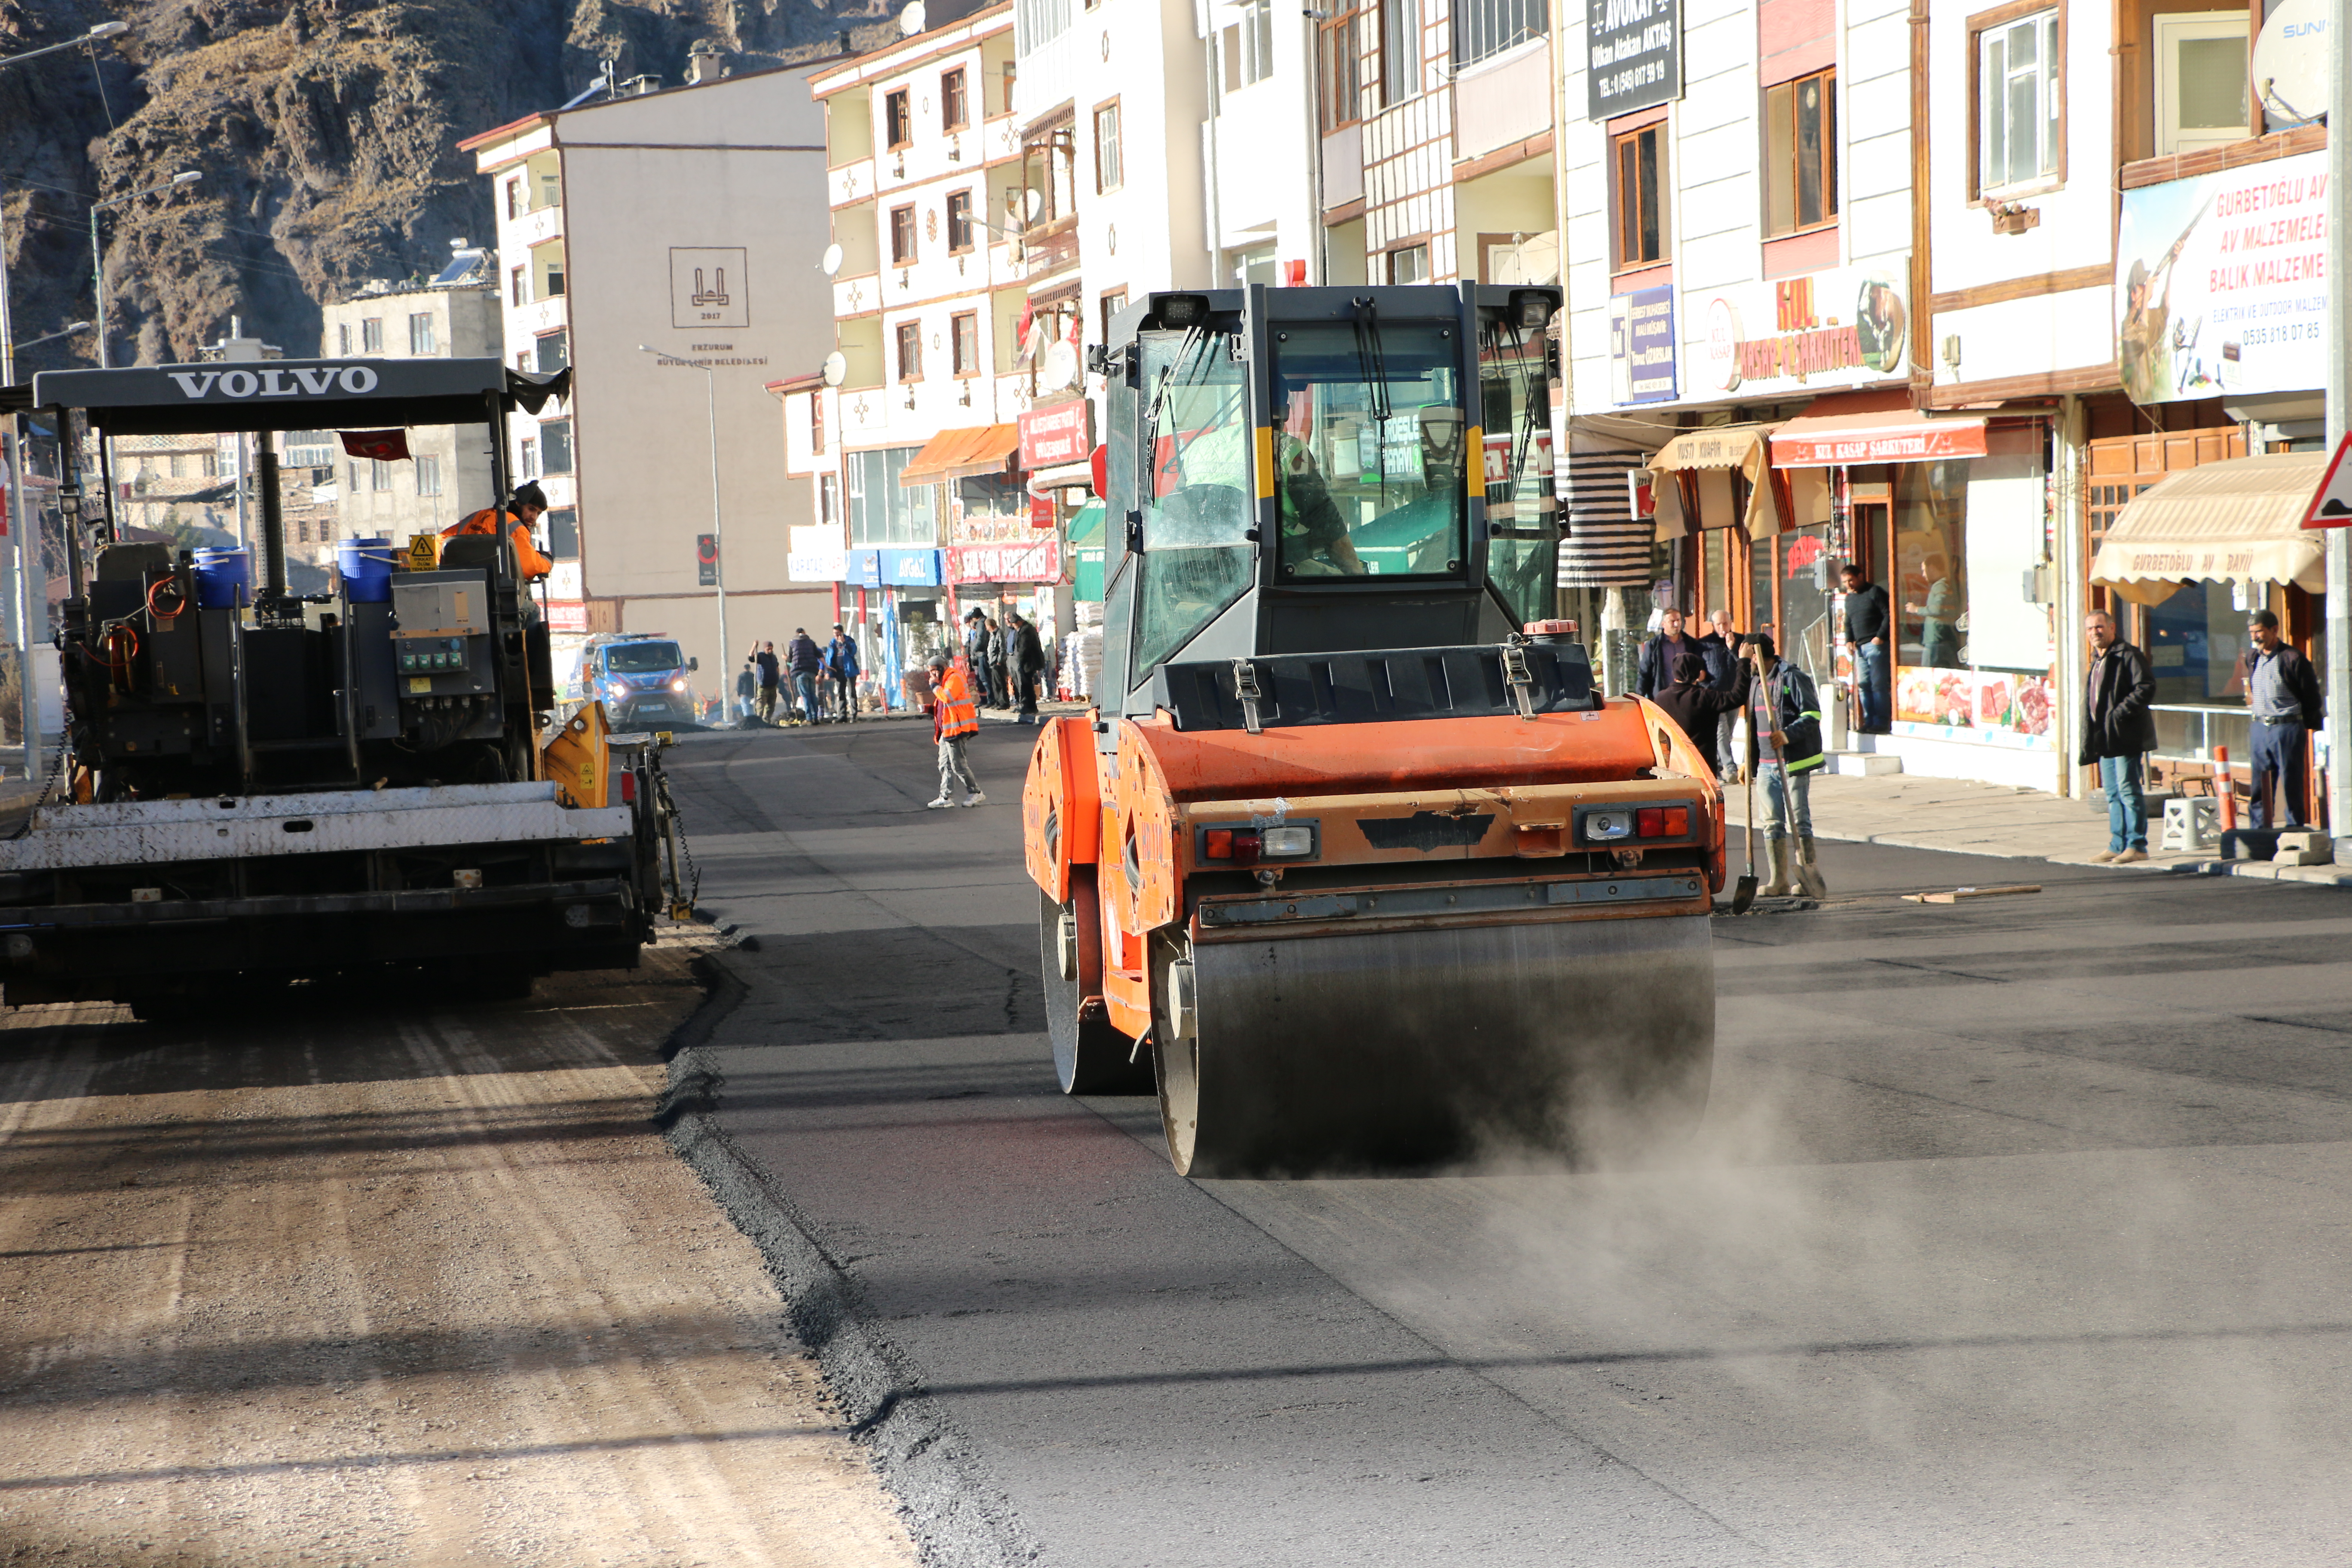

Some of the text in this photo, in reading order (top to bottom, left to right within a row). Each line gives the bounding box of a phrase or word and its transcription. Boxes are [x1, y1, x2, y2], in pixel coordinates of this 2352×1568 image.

[1592, 20, 1671, 70] Utkan Atakan AKTAŞ
[1619, 69, 1634, 97] (545)
[1635, 65, 1646, 87] 617
[1647, 62, 1655, 84] 59
[1656, 59, 1665, 80] 19
[2217, 172, 2328, 218] GURBETOĞLU AV
[2220, 228, 2240, 254] AV
[2210, 252, 2328, 293] BALIK MALZEME
[1776, 277, 1813, 331] KUL
[2248, 305, 2257, 318] VE
[2260, 300, 2292, 317] OUTDOOR
[2243, 322, 2319, 346] 0535 818 07 85
[1710, 344, 1731, 360] KASAP
[1741, 338, 1778, 380] KASAP
[168, 366, 378, 398] VOLVO
[1815, 444, 1833, 459] KUL
[1836, 441, 1867, 459] KASAP
[898, 557, 926, 578] AYGAZ
[2133, 550, 2193, 572] GURBETOĞLU
[2202, 554, 2214, 572] AV
